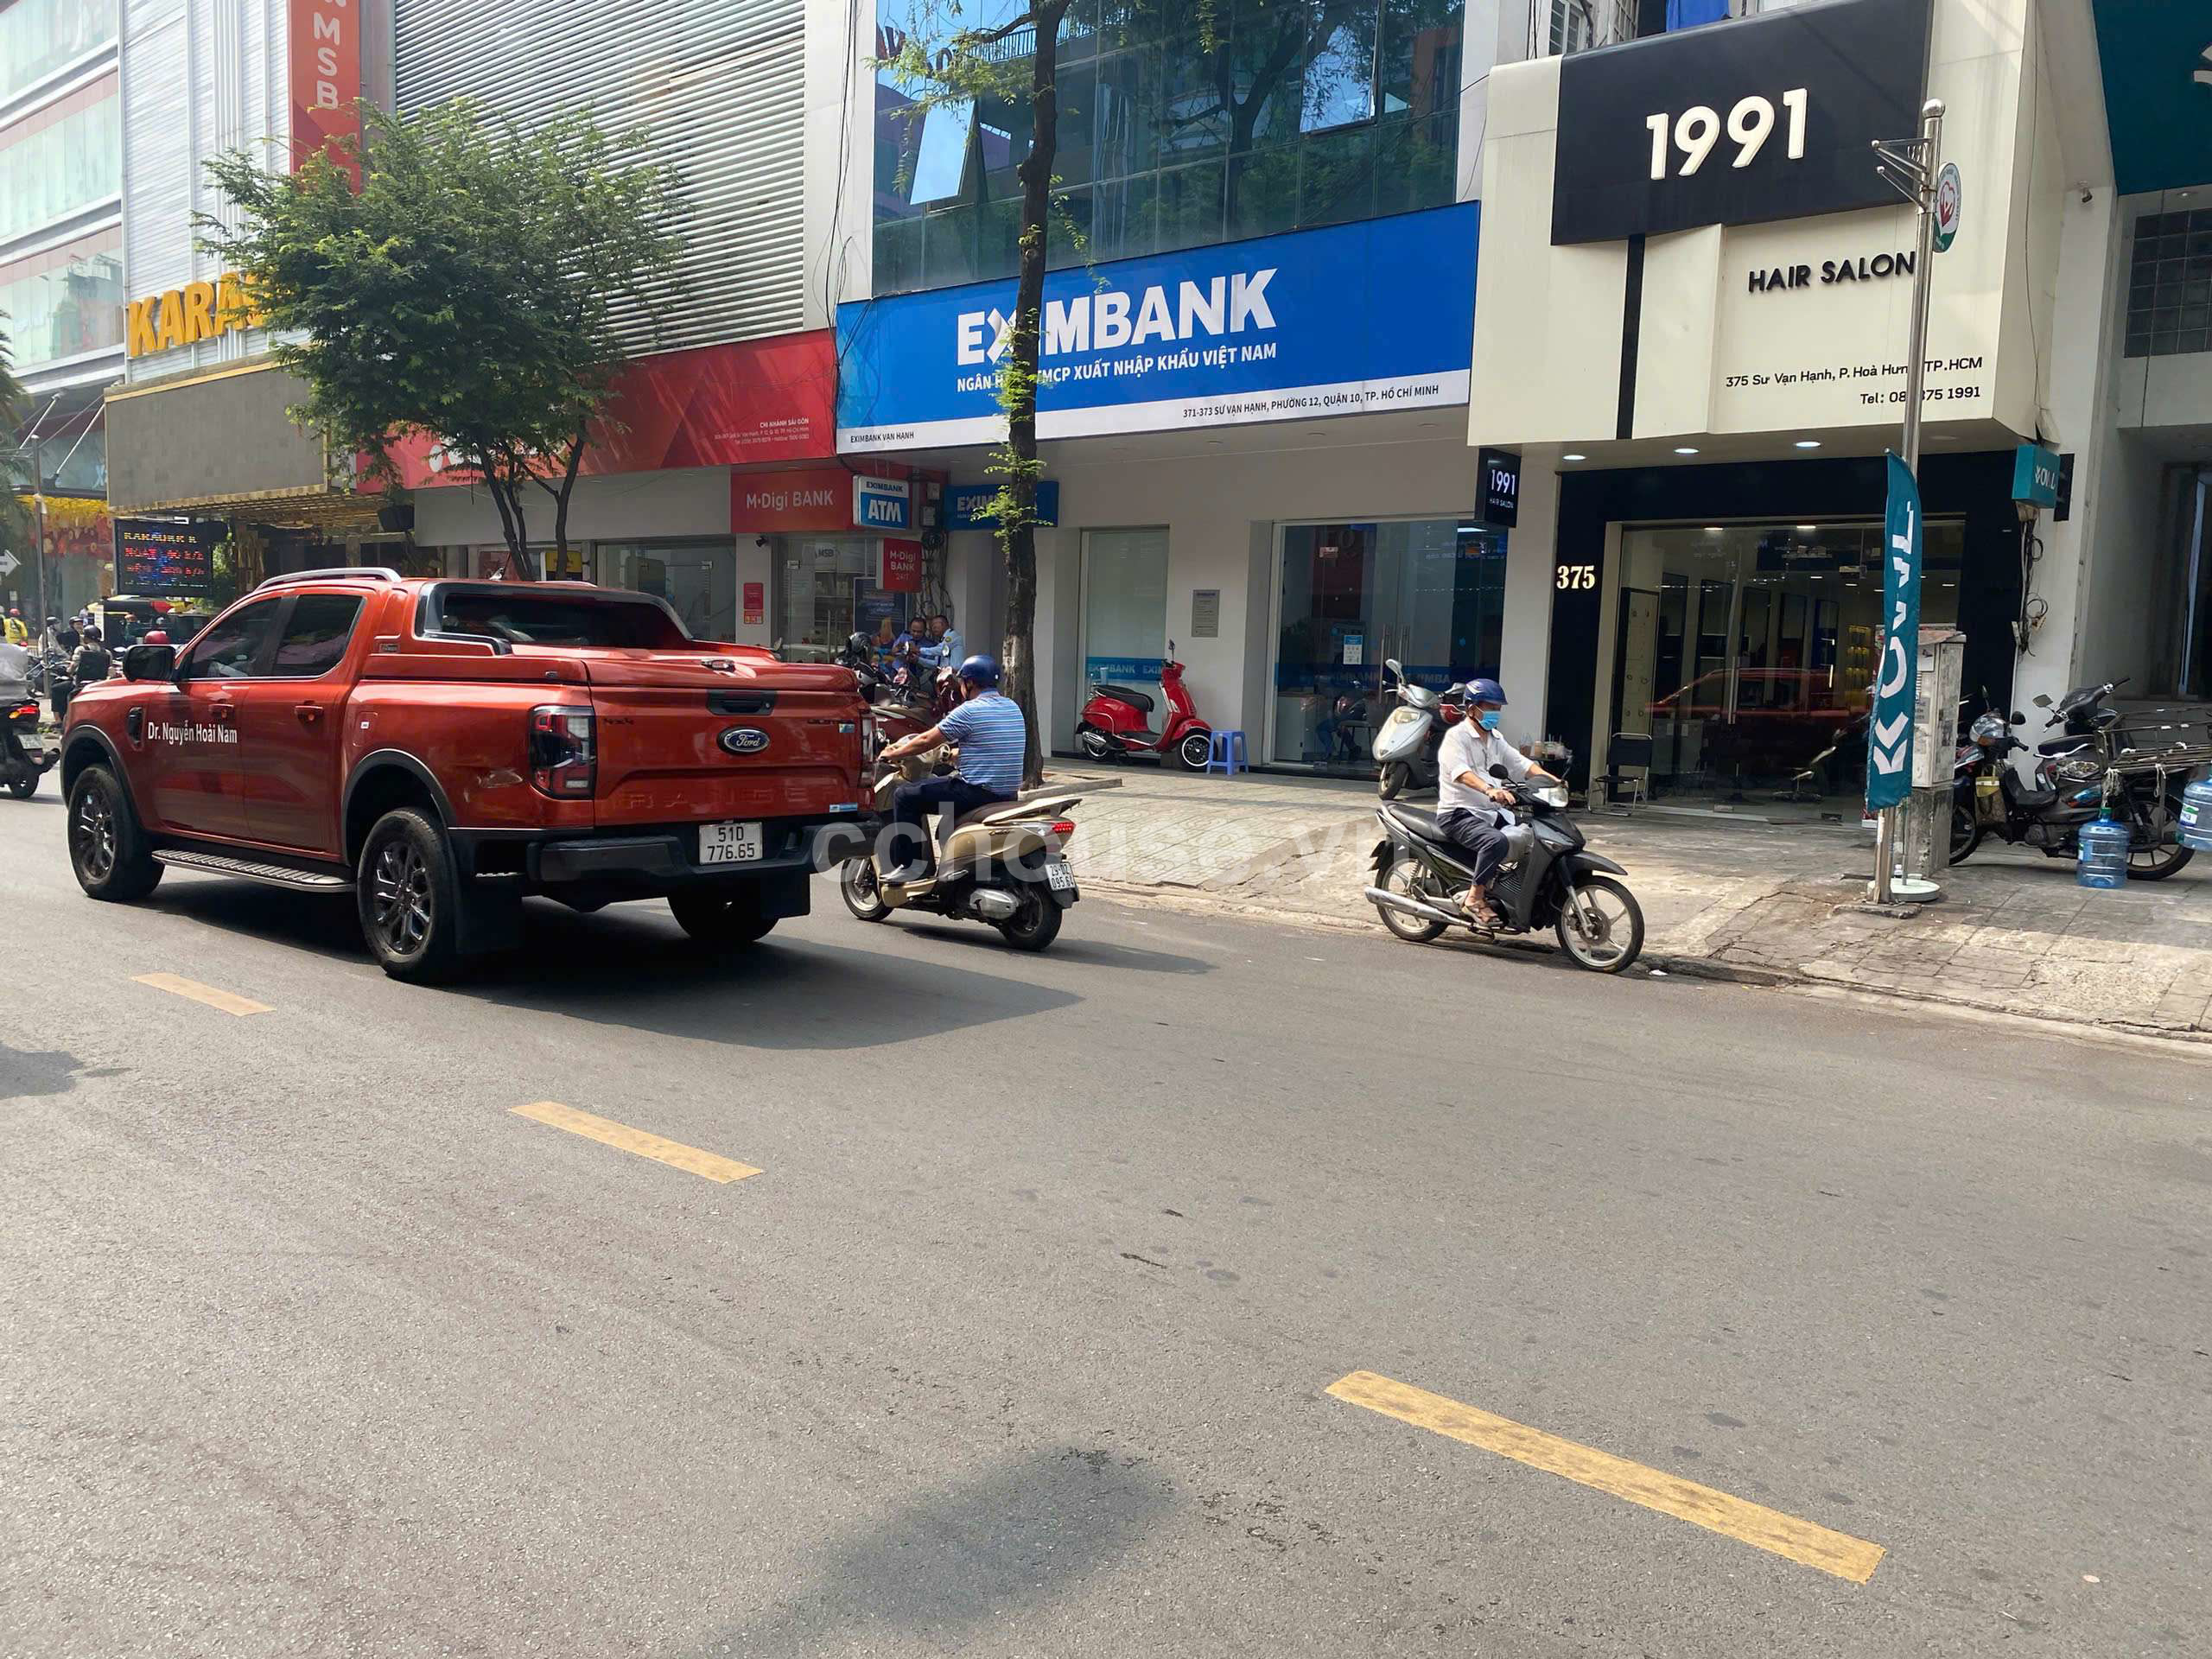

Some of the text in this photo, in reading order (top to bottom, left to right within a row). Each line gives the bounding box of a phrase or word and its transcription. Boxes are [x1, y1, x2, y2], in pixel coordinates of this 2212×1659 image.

[1646, 88, 1808, 181] 1991
[1748, 251, 1916, 293] HAIR SALON
[957, 268, 1278, 365] EXMBANK
[957, 372, 991, 392] NGÂN
[1074, 358, 1111, 381] XUẤT
[1114, 355, 1154, 378] NHẬP
[1157, 347, 1199, 372] KHẨU
[1203, 346, 1237, 369] VIỆT
[1241, 342, 1277, 362] NAM
[1726, 356, 1983, 388] 375 Sư Vạn Hạnh, P. Hoà Hưn TP.HCM
[1183, 407, 1213, 418] 371-373
[1225, 404, 1242, 417] VẠN
[1243, 401, 1270, 413] HẠNH,
[1309, 397, 1322, 409] 12,
[1324, 392, 1348, 407] QUẬN
[1350, 393, 1363, 404] 10,
[1365, 391, 1379, 403] TP.
[1382, 386, 1395, 400] HỒ
[1396, 385, 1413, 398] CHÍ
[1414, 385, 1440, 397] MINH
[1860, 392, 1885, 404] Tel:
[1889, 391, 1906, 403] 08
[1947, 386, 1980, 399] 1991
[850, 433, 882, 443] EXIMBANK
[867, 480, 904, 493] EXIMBANK
[1491, 469, 1516, 496] 1991
[792, 490, 834, 508] BANK
[868, 499, 902, 524] ATM
[890, 561, 914, 571] BANK
[1556, 564, 1596, 589] 375
[148, 719, 238, 746] Dr. Nguyễn Hoài Nam
[736, 733, 761, 748] Ford
[718, 826, 745, 843] 51D
[706, 842, 756, 862] 776.65
